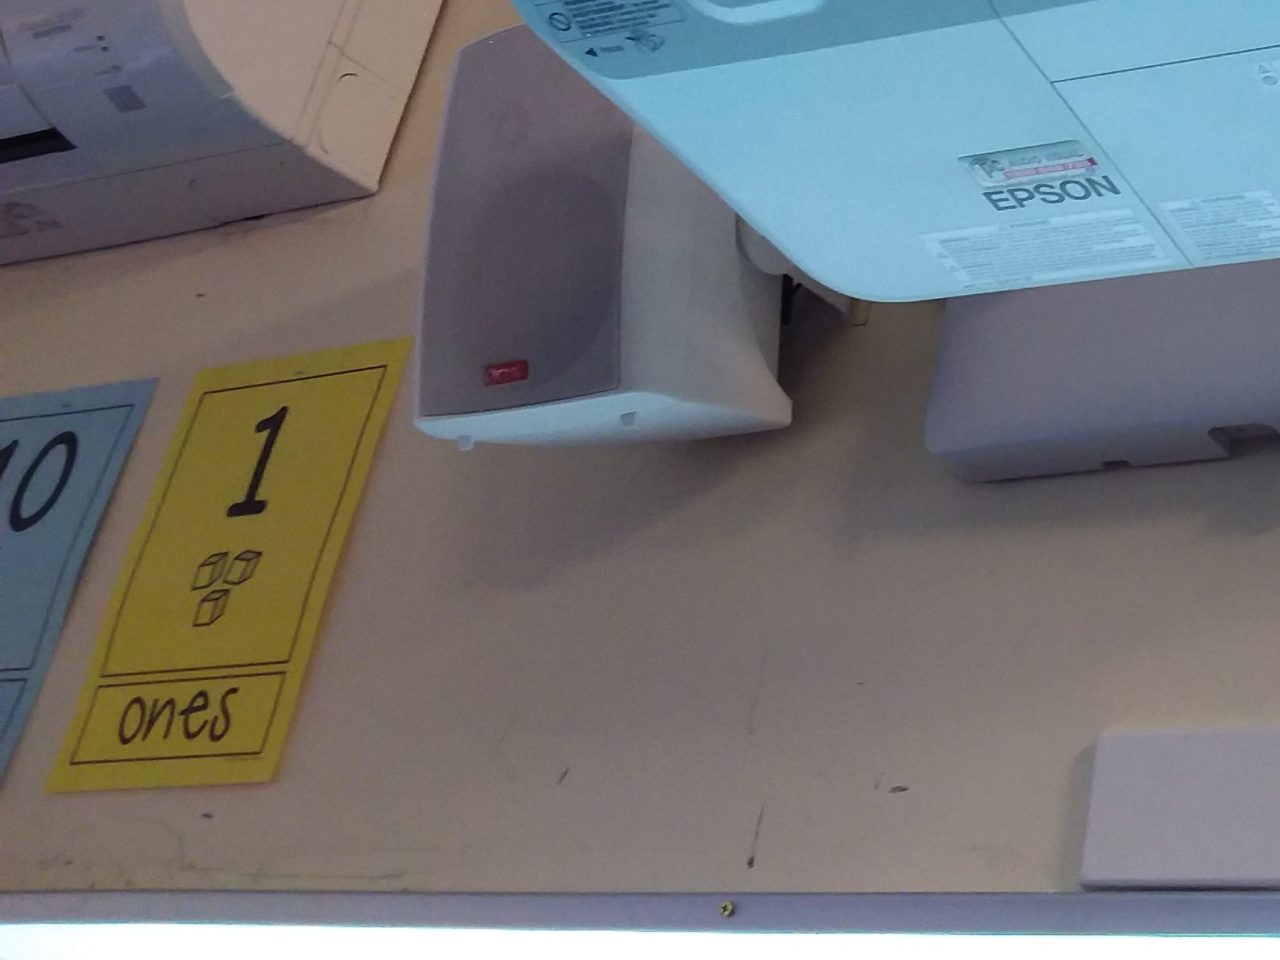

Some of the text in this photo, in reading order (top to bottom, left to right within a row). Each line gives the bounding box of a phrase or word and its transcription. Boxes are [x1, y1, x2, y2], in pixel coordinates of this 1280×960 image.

[981, 175, 1122, 212] EPSON
[226, 405, 290, 518] 1
[118, 686, 241, 746] ones
